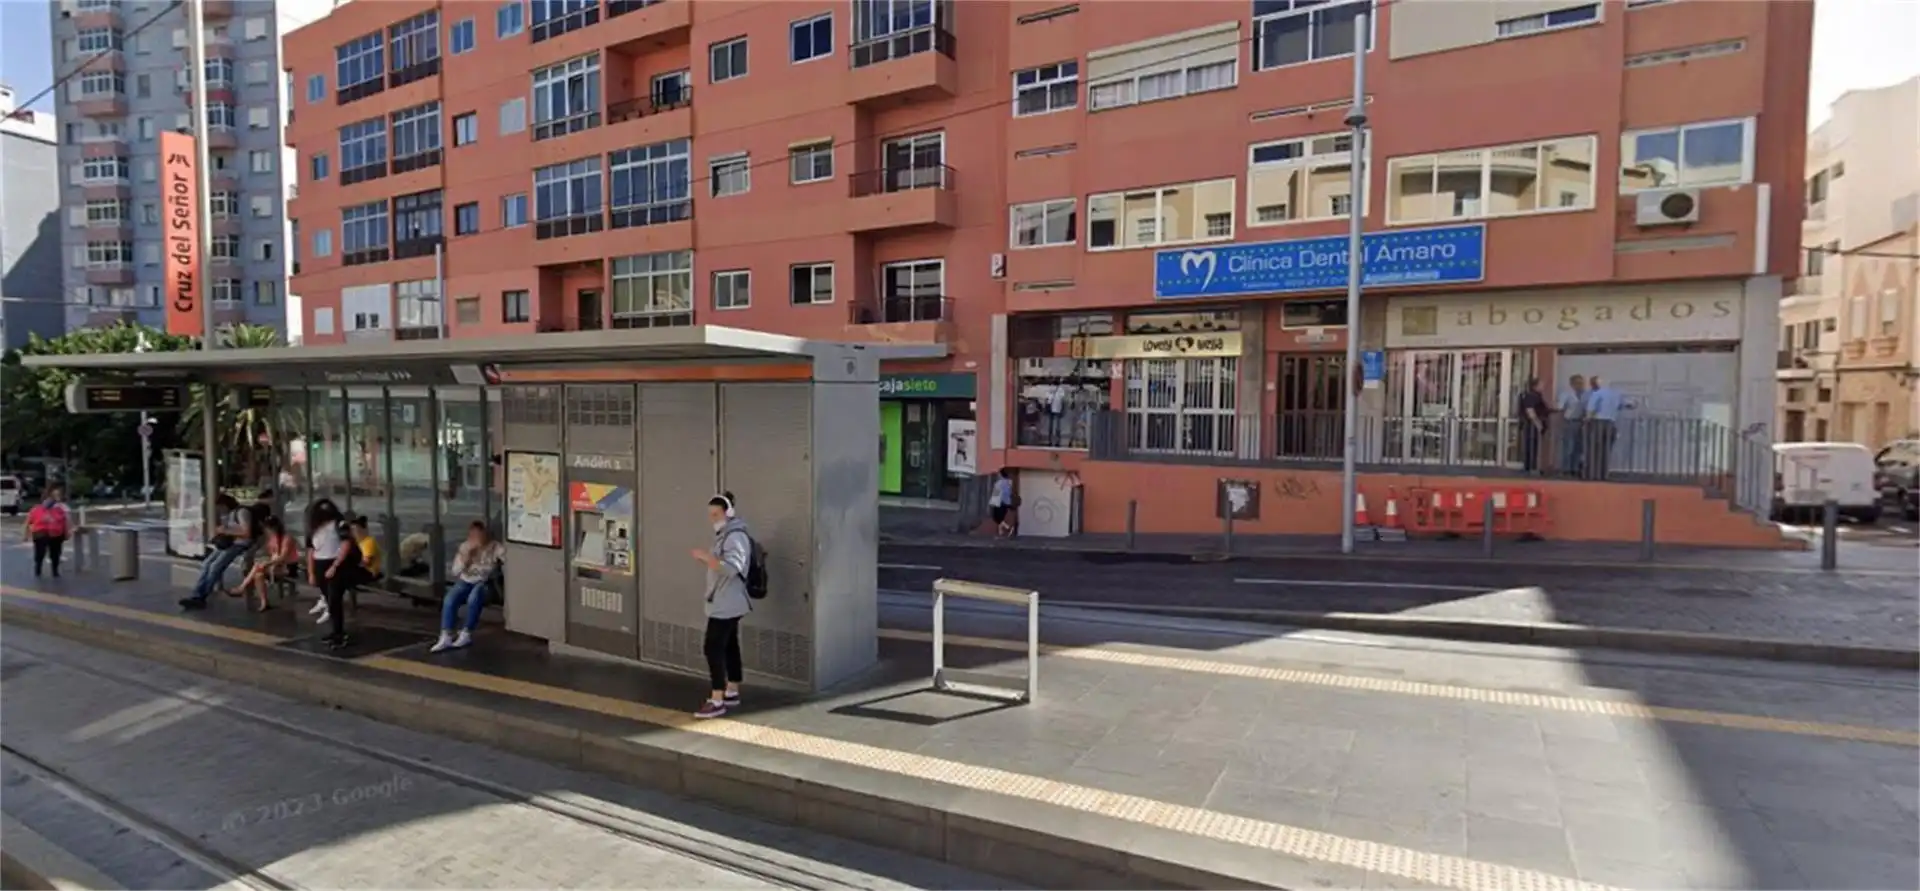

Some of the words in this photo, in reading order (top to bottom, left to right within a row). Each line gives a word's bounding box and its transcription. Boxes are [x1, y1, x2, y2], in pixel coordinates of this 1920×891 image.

[168, 172, 191, 230] Señor
[171, 236, 192, 266] del
[1299, 246, 1369, 269] Dentl
[1374, 243, 1457, 263] Amaro
[174, 271, 193, 313] Cruz
[1457, 296, 1731, 331] abogados
